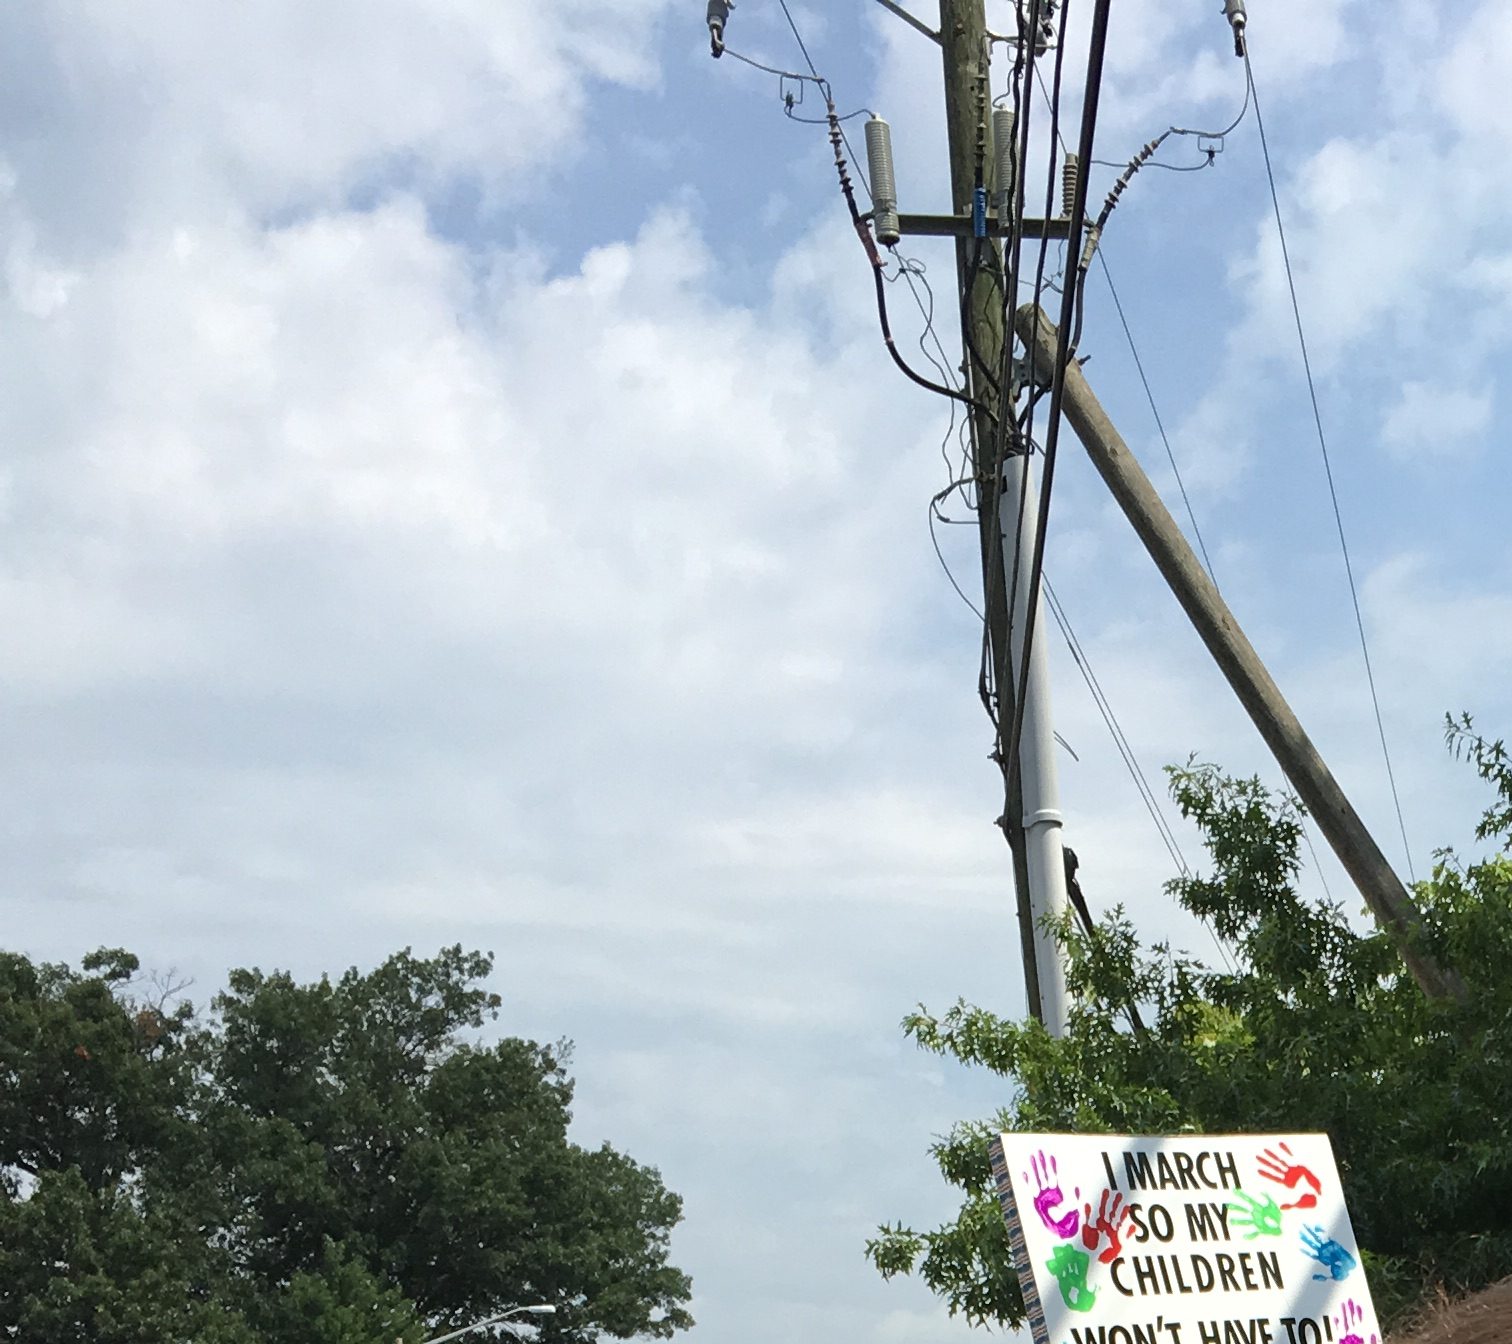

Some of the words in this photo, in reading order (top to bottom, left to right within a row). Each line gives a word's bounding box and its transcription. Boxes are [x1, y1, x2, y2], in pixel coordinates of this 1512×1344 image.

[1101, 1151, 1118, 1191] I
[1122, 1151, 1241, 1190] MARCH
[1129, 1204, 1174, 1243] SO
[1185, 1202, 1232, 1242] MY
[1109, 1251, 1284, 1297] CHILDREN
